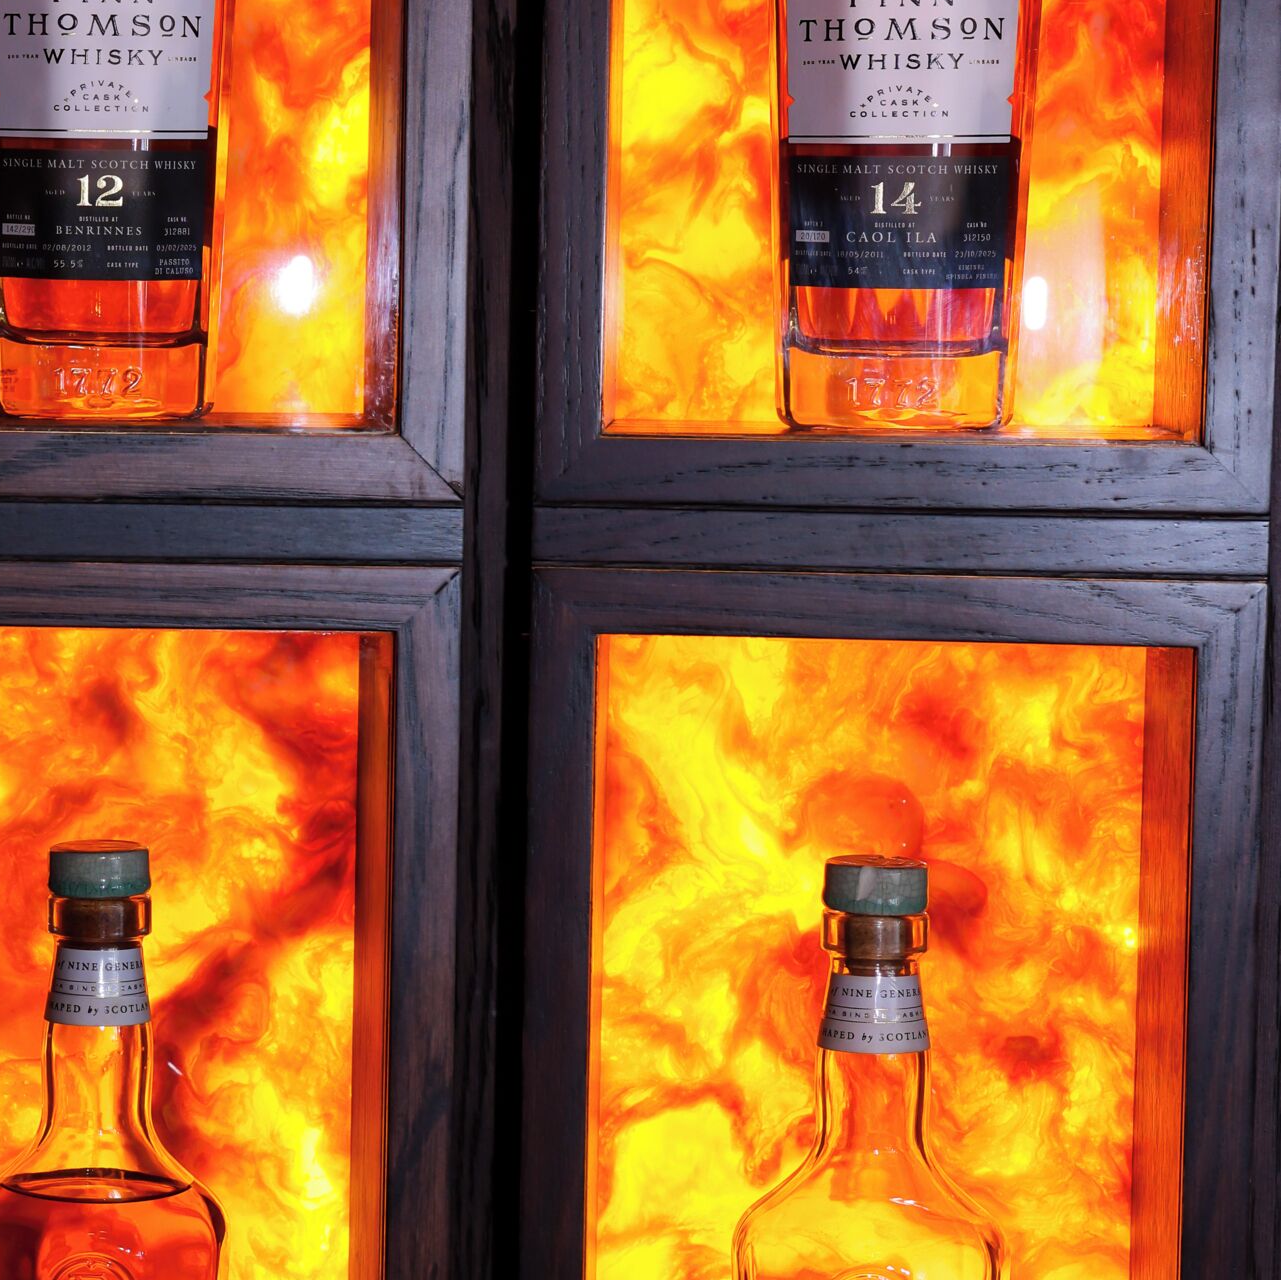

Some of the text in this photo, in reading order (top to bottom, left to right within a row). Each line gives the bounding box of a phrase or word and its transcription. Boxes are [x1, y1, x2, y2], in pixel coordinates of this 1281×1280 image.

[4, 13, 202, 38] THOMSON
[799, 17, 1005, 42] THOMSON
[43, 48, 163, 66] WHISKY
[839, 53, 964, 70] WHISKY
[70, 80, 132, 98] PRIVATE
[867, 85, 931, 103] PRIVATE
[82, 93, 121, 101] CASK
[53, 104, 149, 113] COLLECTION
[850, 110, 949, 118] COLLECTION
[2, 158, 196, 170] SINGLE MALT SCOTCH WHISKY
[797, 163, 998, 175] SINGLE MALT SCOTCH WHISKY
[76, 174, 123, 207] 12
[870, 181, 922, 215] 14
[55, 225, 142, 236] BENRINNES
[846, 231, 937, 243] CAOL ILA
[67, 961, 98, 971] NINE
[842, 988, 872, 998] NINE
[861, 1032, 873, 1043] by
